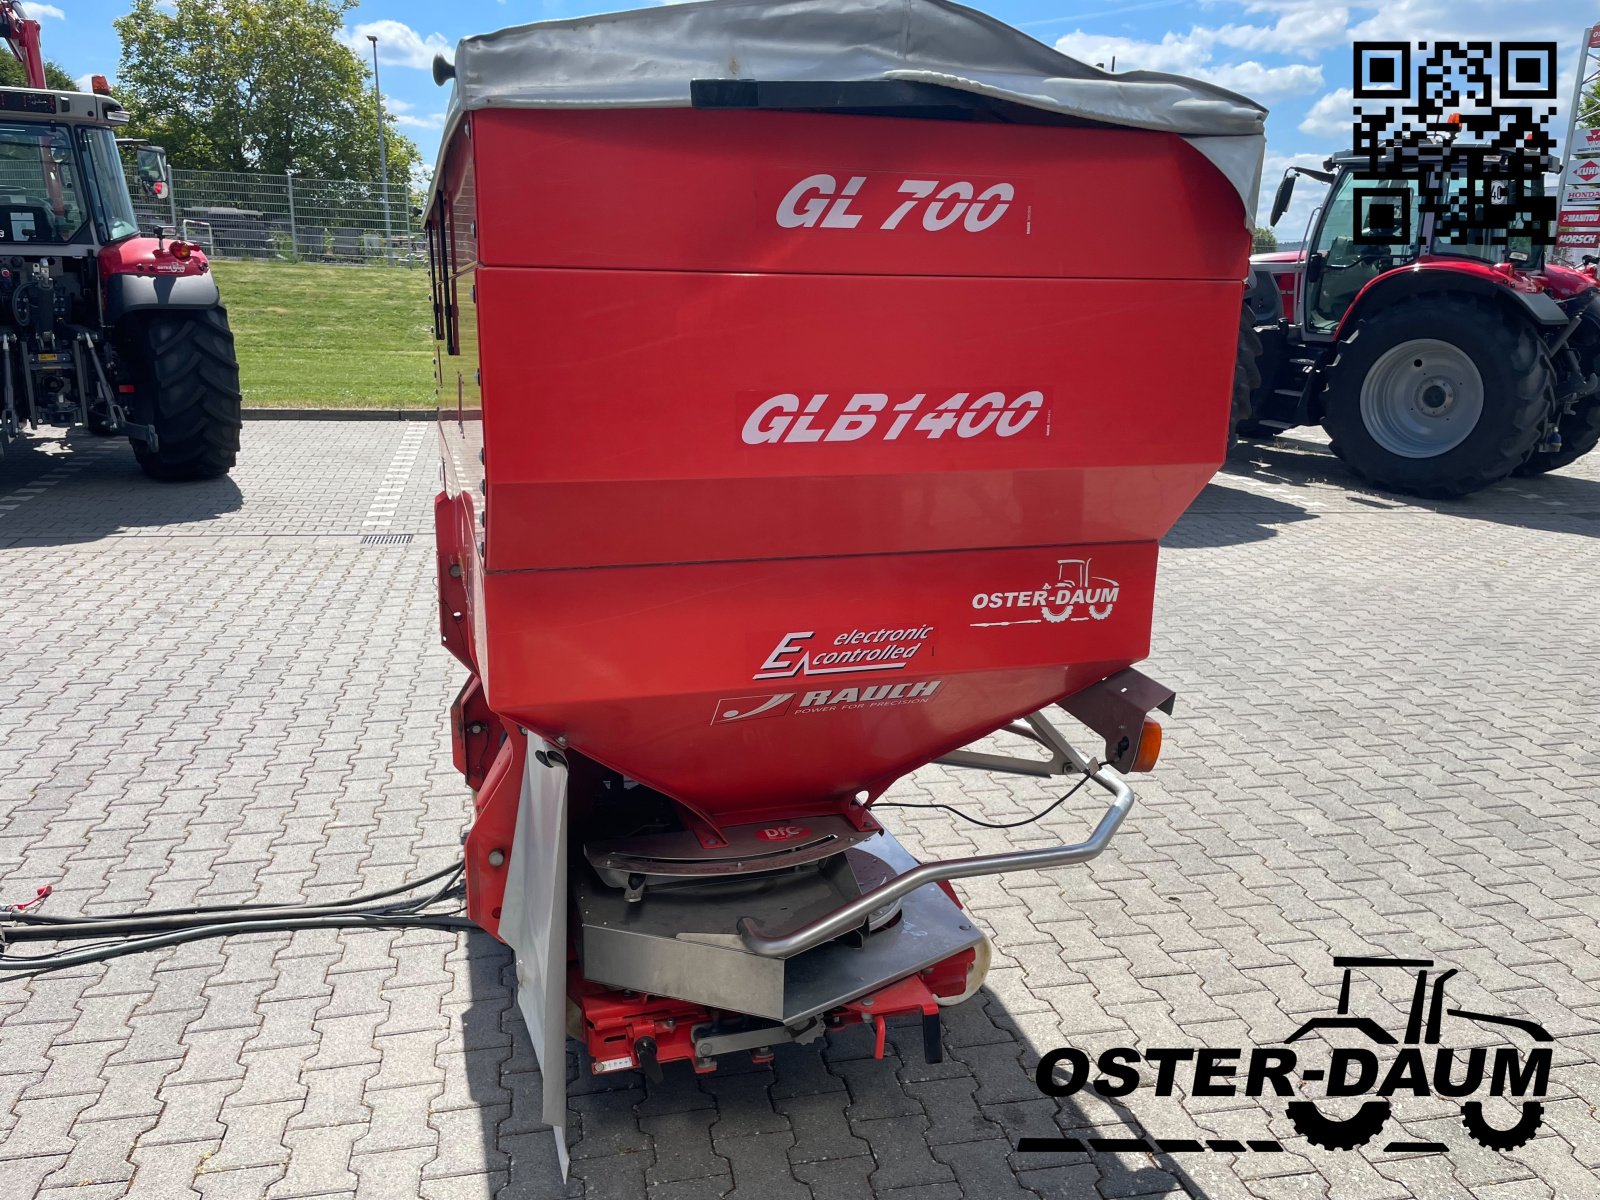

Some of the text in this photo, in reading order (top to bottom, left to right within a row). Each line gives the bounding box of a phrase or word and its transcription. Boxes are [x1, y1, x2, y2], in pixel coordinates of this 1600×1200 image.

[776, 174, 867, 228] GL
[880, 180, 1014, 233] 700
[1559, 234, 1597, 243] HORSCH
[972, 587, 1120, 609] OSTER-DAUM
[833, 624, 934, 646] electronic
[812, 642, 922, 666] controlled
[799, 680, 942, 708] RAUCH
[794, 705, 837, 715] POWER
[870, 698, 929, 708] PRECISION
